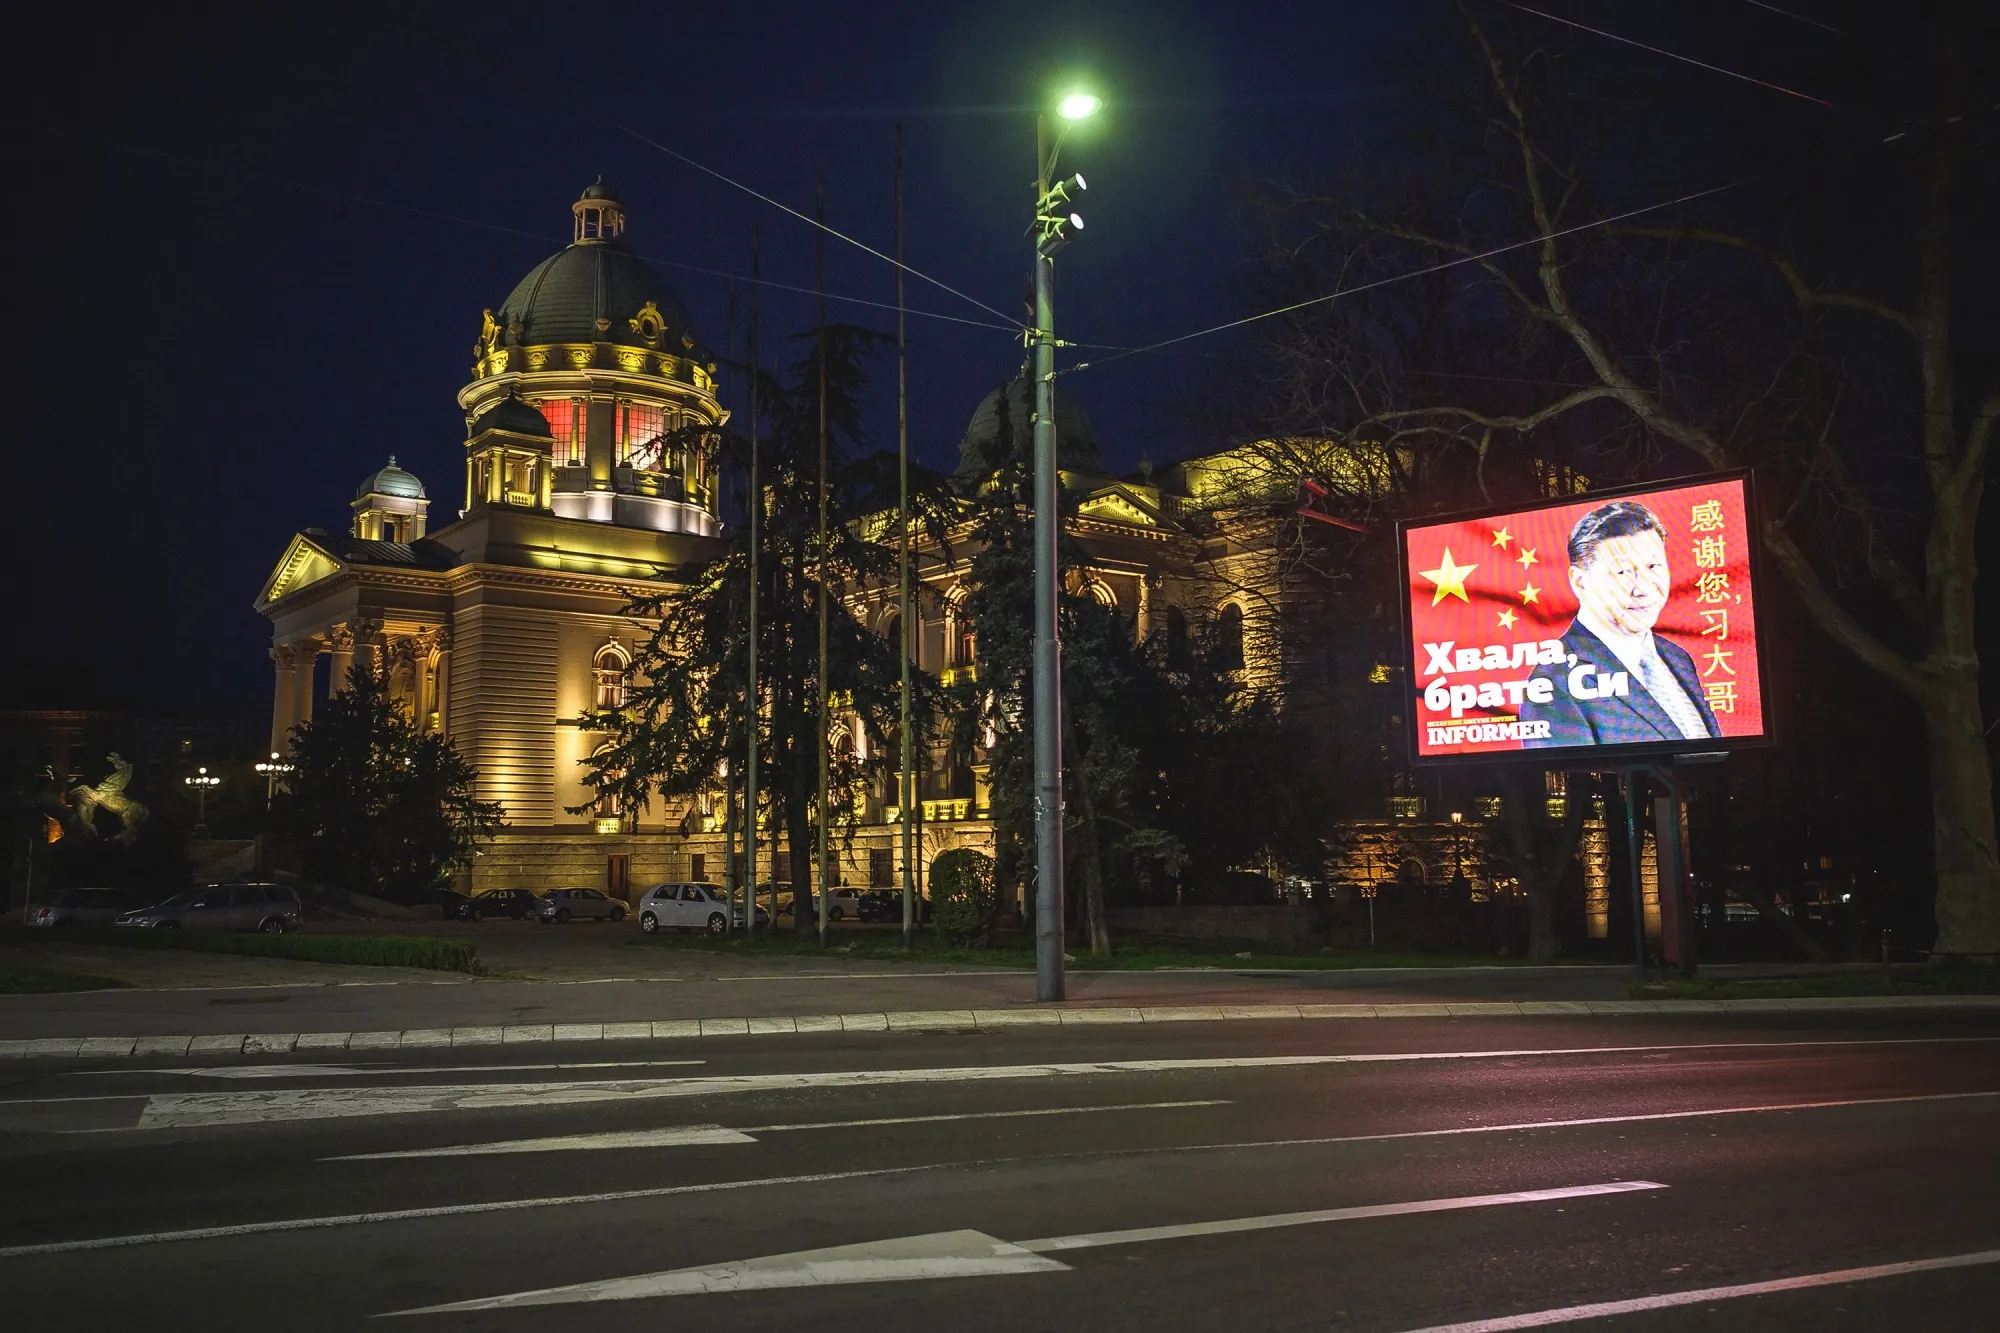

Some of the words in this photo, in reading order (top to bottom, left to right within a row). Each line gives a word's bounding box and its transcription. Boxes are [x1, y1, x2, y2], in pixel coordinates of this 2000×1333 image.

[1423, 639, 1578, 675] Хвала,
[1424, 676, 1554, 718] брате
[1567, 664, 1630, 700] Си
[1427, 720, 1552, 745] INFORMER
